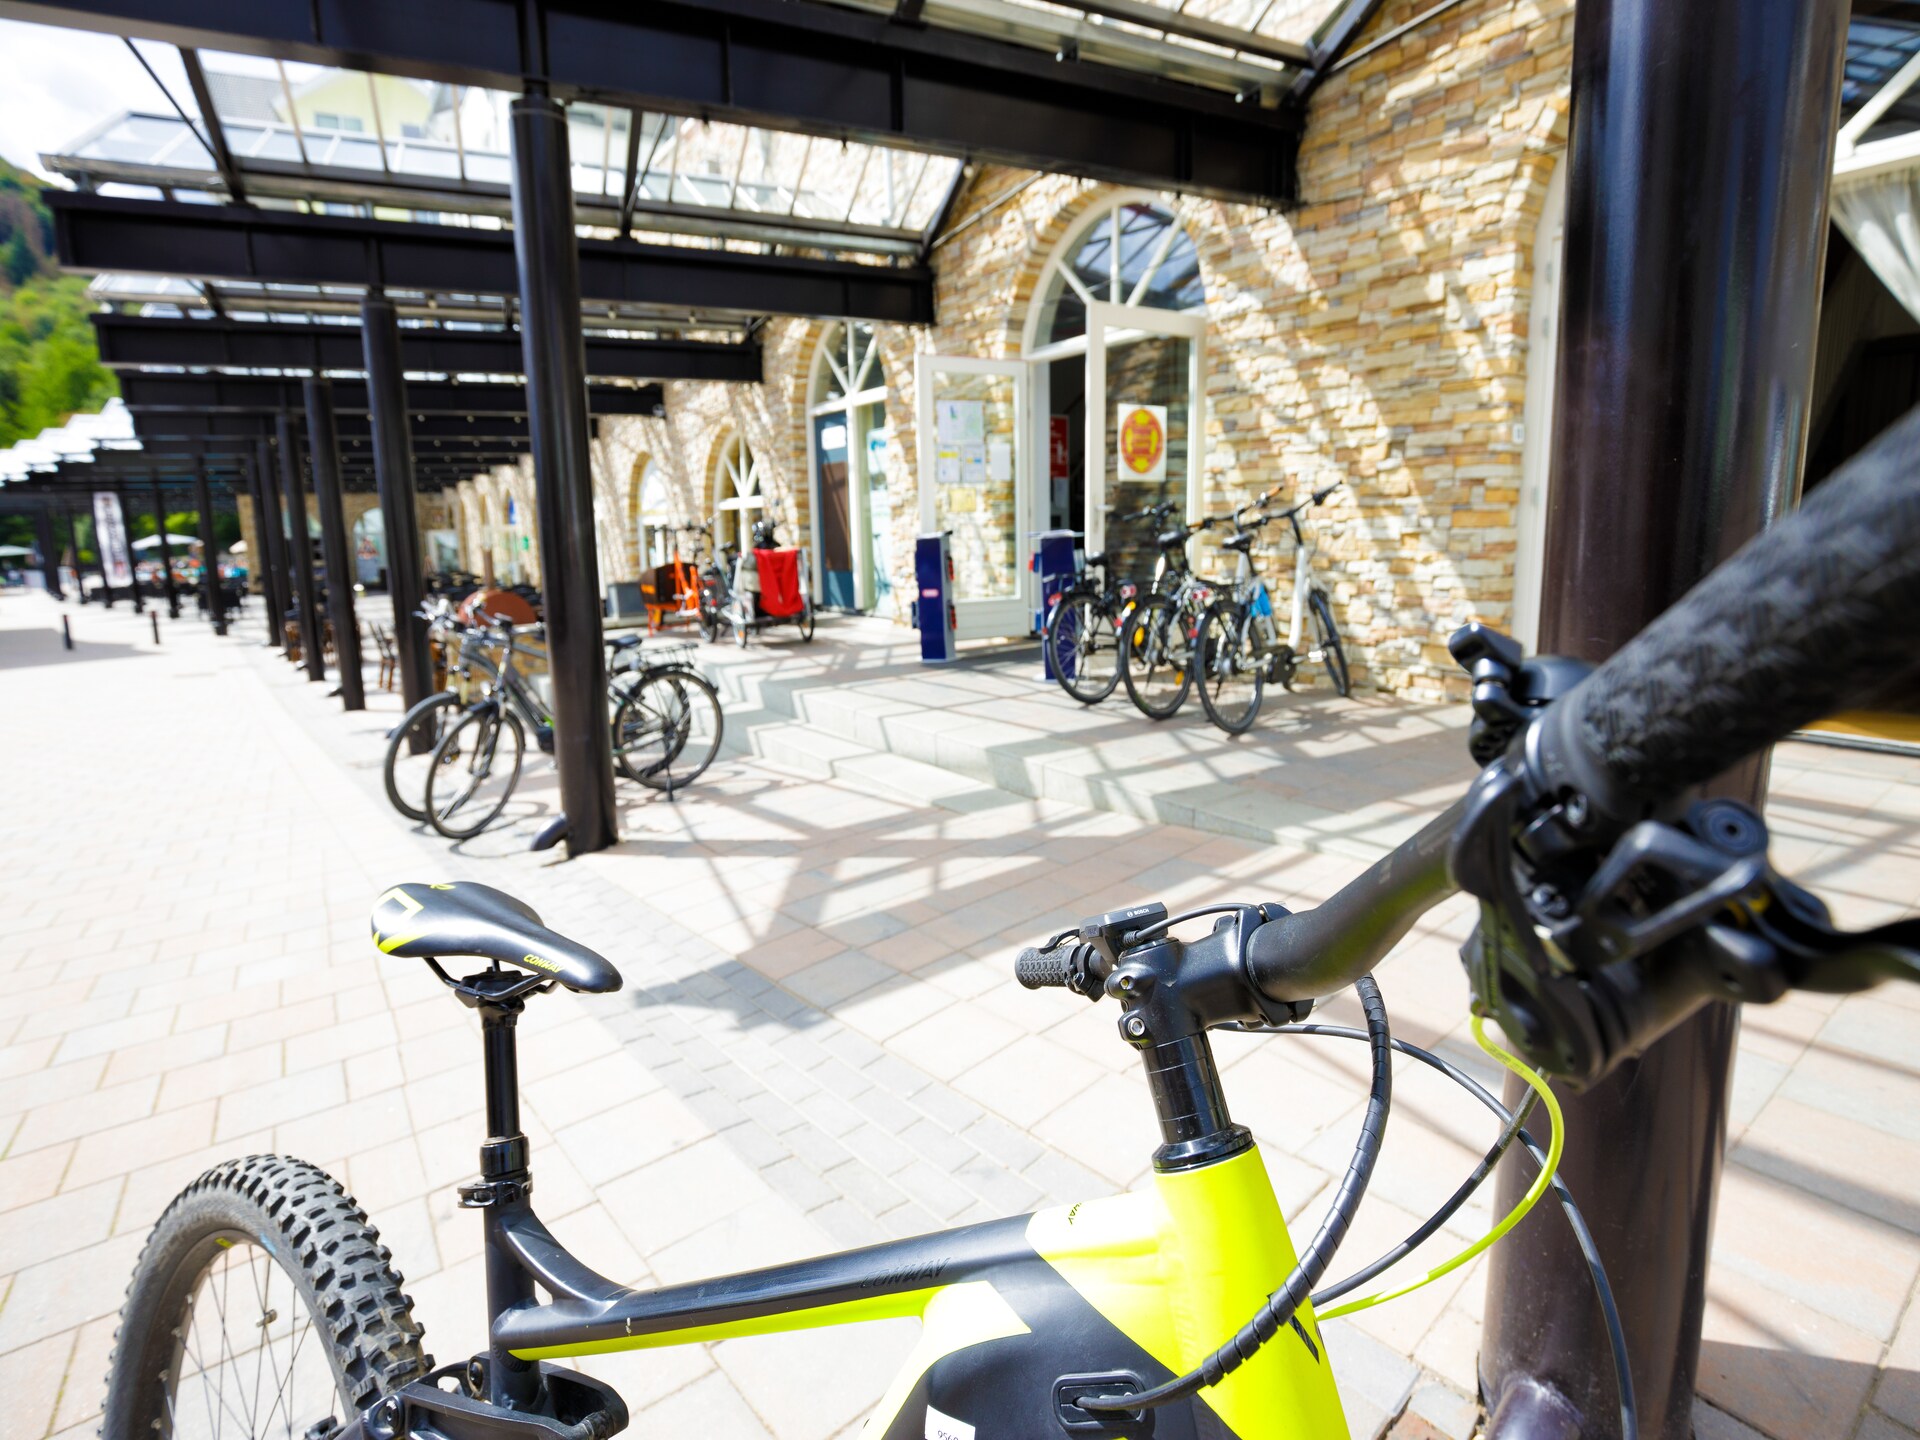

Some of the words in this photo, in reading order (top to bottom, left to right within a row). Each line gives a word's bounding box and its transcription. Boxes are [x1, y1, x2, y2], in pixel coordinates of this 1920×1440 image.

[1133, 908, 1150, 916] BOSCH
[523, 953, 565, 973] CONWAY
[859, 1257, 951, 1288] CONWAY
